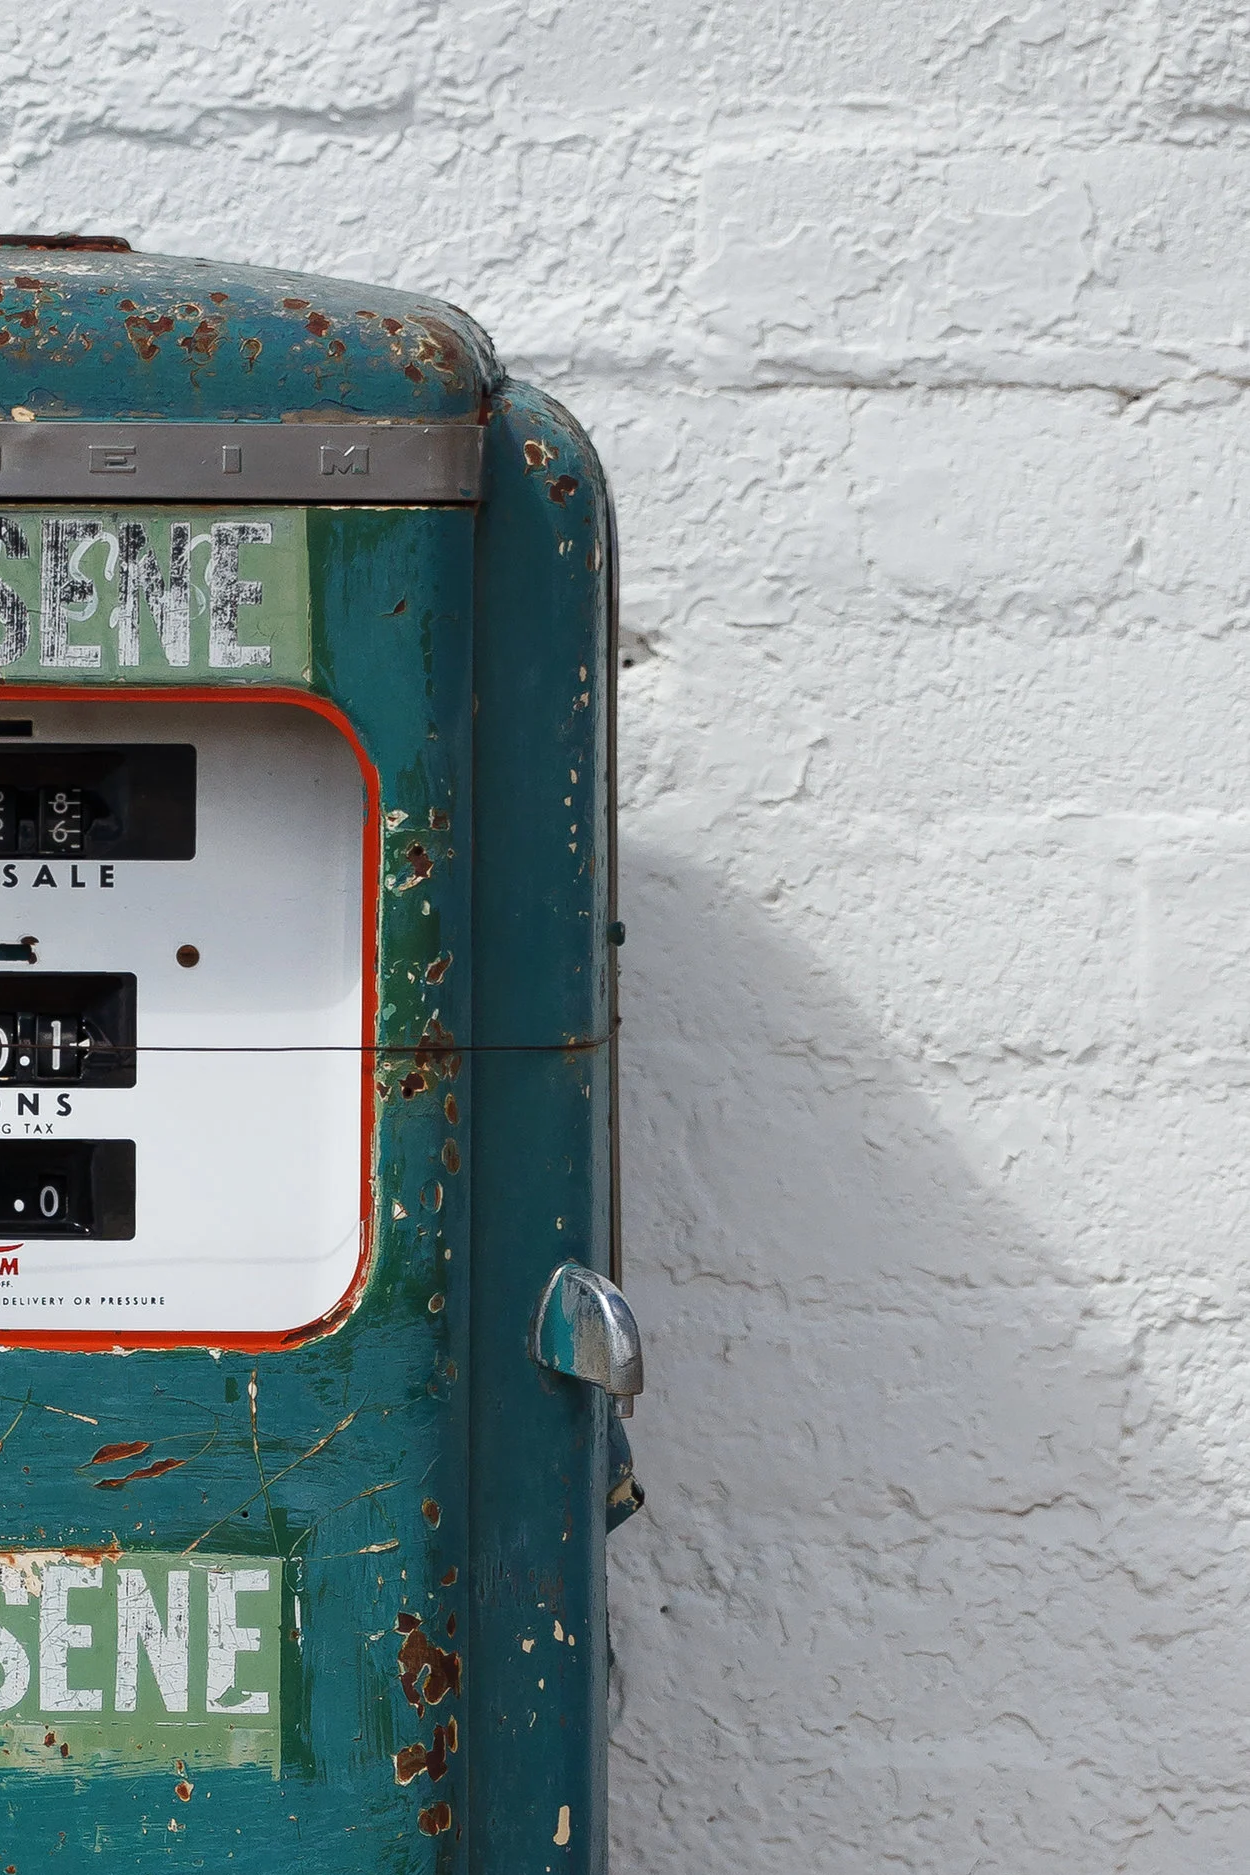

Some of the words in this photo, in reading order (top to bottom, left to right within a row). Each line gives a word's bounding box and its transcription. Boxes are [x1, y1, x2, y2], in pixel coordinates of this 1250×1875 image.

[2, 864, 116, 889] SALE
[23, 1122, 55, 1135] TAX
[2, 1296, 65, 1306] DELIVERY
[73, 1296, 92, 1306] OR
[100, 1296, 166, 1306] PRESSURE
